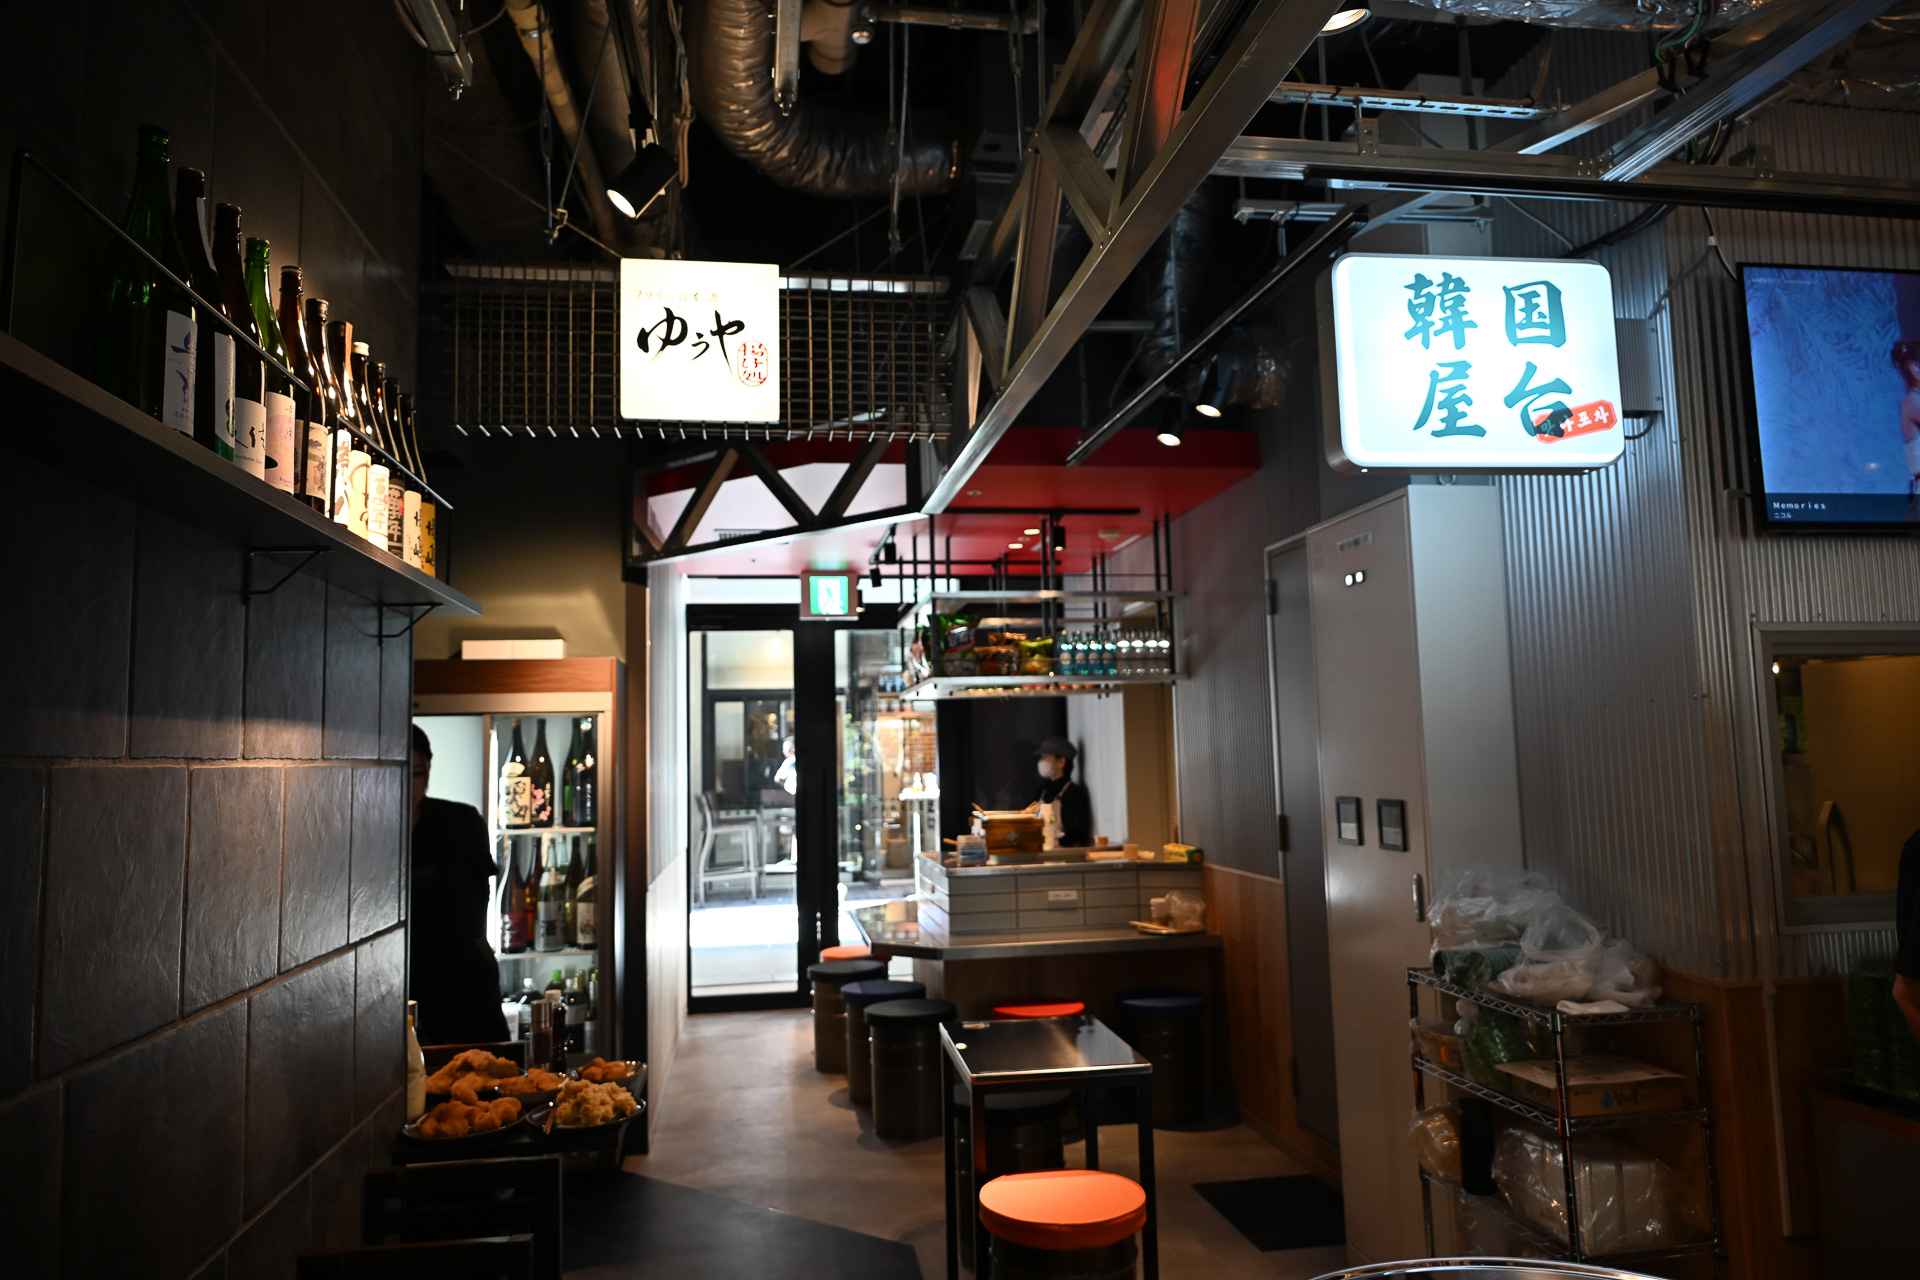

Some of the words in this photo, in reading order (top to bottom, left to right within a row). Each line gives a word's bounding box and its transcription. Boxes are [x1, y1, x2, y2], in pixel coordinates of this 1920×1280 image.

[636, 306, 746, 382] ゆうや
[1403, 271, 1567, 350] 韓国
[1412, 359, 1574, 438] 屋台
[1772, 501, 1826, 510] Memories
